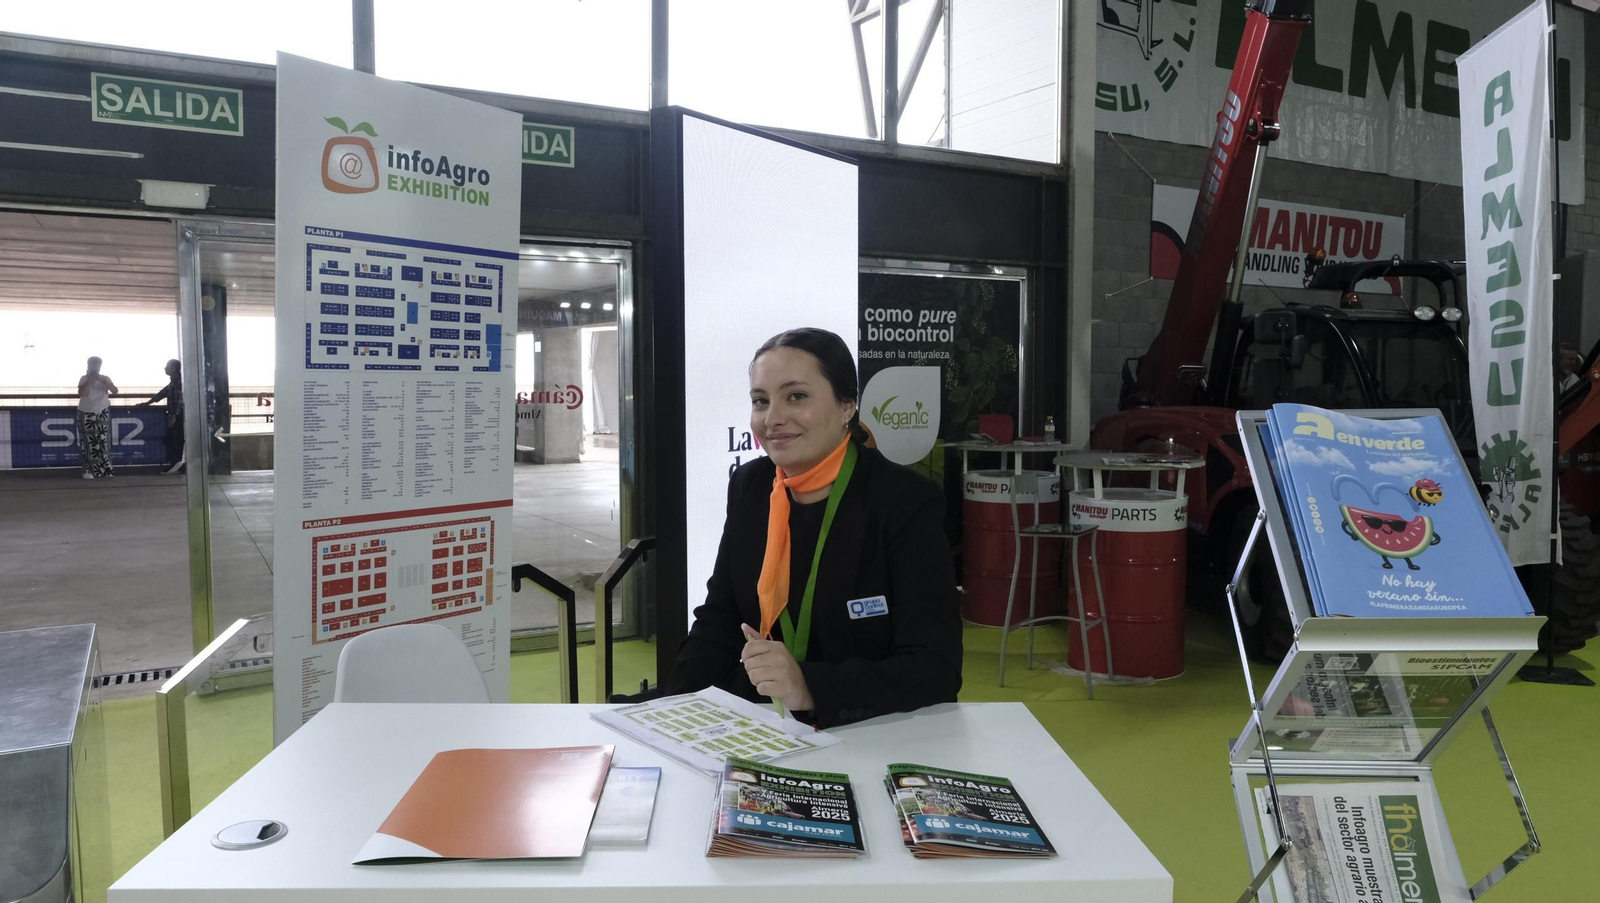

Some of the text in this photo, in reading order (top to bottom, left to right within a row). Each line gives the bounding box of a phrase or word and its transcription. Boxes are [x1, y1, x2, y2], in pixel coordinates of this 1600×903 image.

[100, 83, 236, 124] SALIDA
[523, 130, 568, 157] IDA
[388, 145, 490, 187] infoAgro
[388, 174, 490, 206] EXHIBITION
[306, 228, 334, 237] PLANTA
[1249, 207, 1384, 260] MANITOU
[1233, 252, 1299, 274] ANDLING
[865, 308, 957, 327] como pure
[868, 323, 954, 342] biocontrol
[885, 351, 895, 359] en
[898, 349, 905, 359] la
[908, 350, 950, 359] naturaleza
[871, 396, 929, 430] Veganic
[41, 418, 145, 448] SR
[970, 481, 998, 490] MANITOU
[1075, 503, 1157, 521] MANITOU PARTS
[304, 520, 331, 528] PLANTA
[1382, 574, 1437, 592] No hay
[1366, 590, 1421, 602] verano
[865, 602, 884, 610] control
[760, 781, 846, 797] EXHIBITION
[769, 789, 792, 799] Feria
[793, 794, 848, 804] Internacional
[930, 782, 1016, 799] EXHIBITION
[760, 792, 848, 809] Agricultura Intensiva
[937, 795, 1023, 812] Agricultura Intensiva
[944, 791, 964, 799] Feria
[966, 794, 1021, 807] Internacional
[811, 805, 849, 814] Almería
[811, 810, 850, 821] 2025
[989, 808, 1026, 817] Almería
[990, 812, 1030, 825] 2025
[766, 819, 844, 836] cajamar
[954, 823, 1030, 838] cajamar
[1351, 806, 1370, 854] Infoagro
[1333, 796, 1368, 896] del sector agrario
